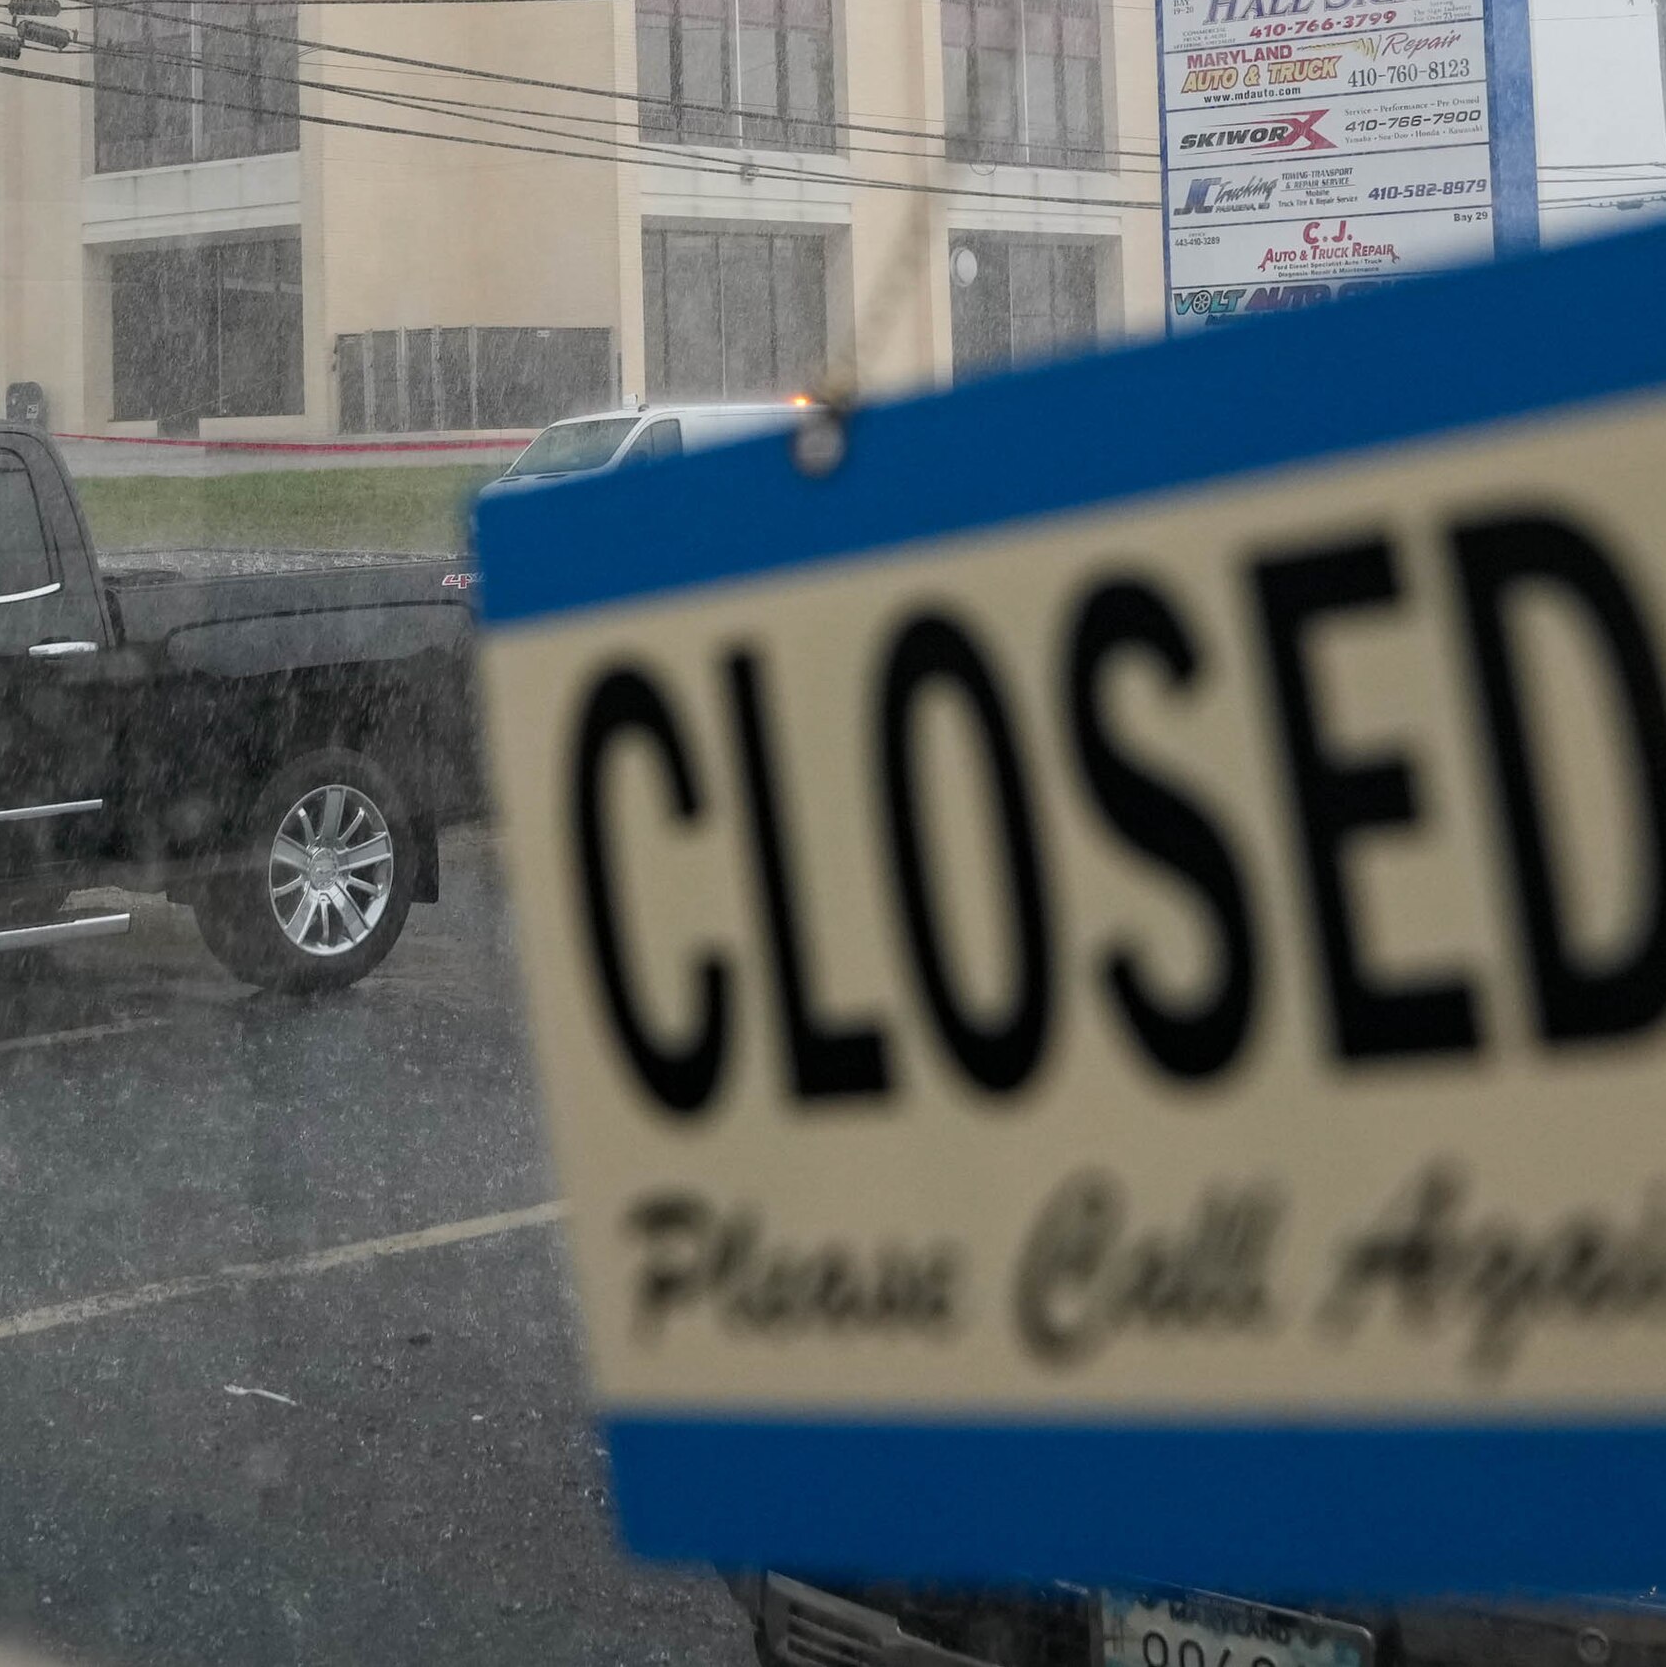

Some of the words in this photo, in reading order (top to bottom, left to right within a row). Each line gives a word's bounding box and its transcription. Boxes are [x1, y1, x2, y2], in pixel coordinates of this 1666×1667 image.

[1249, 10, 1397, 39] 410-766-3799
[1187, 44, 1293, 69] MARYLAND
[1382, 29, 1462, 59] Repair
[1181, 67, 1238, 94] AUTO
[1243, 64, 1261, 87] &
[1267, 55, 1343, 84] TRUCK
[1347, 57, 1471, 88] 410-760-8123
[1203, 86, 1302, 104] www.mdauto.com
[1344, 109, 1482, 133] 410-766-7900
[1321, 177, 1350, 187] SERVICE
[1367, 178, 1487, 201] 410-582-8979
[1453, 212, 1473, 223] Bay
[1475, 210, 1488, 221] 29
[1259, 247, 1297, 267] AUTO
[1299, 249, 1308, 261] &
[1310, 243, 1350, 261] TRUCK
[1351, 241, 1396, 259] REPAIR
